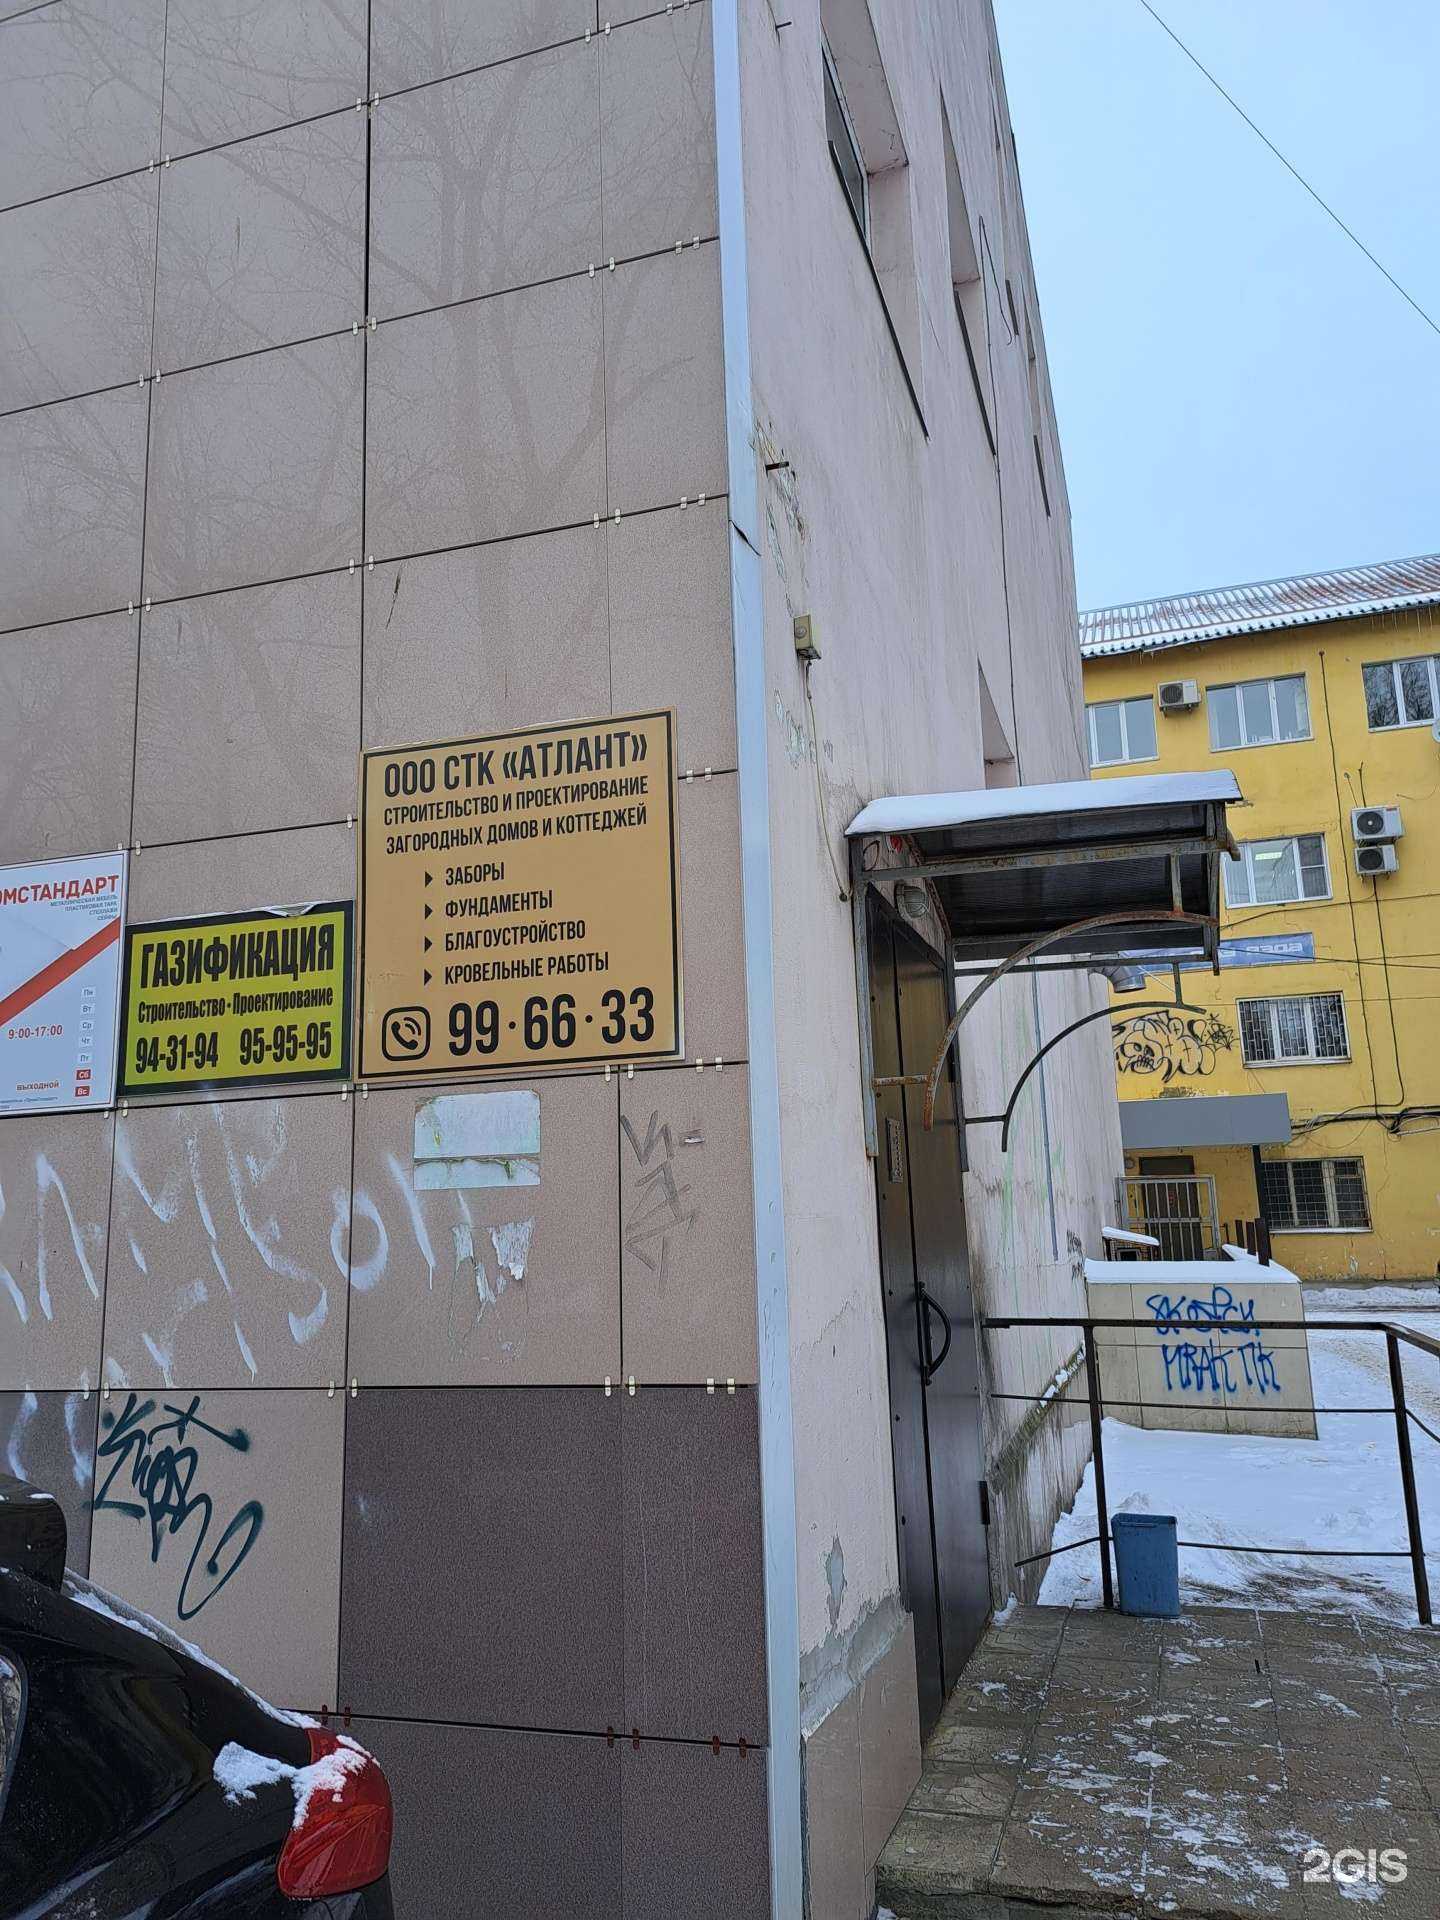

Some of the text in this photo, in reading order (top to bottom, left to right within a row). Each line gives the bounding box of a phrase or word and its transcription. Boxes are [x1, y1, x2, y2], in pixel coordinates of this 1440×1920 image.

[384, 731, 648, 798] ООО СТК «АТЛАНТ»
[384, 775, 649, 826] СТРОИТЕЛЬСТВО И ПРОЕКТИРОВАНИЕ
[386, 802, 647, 855] ЗАГОРОДНЫХ ДОМОВ И КОТТЕДЖЕЙ
[0, 875, 119, 906] МСТАНДАРТ
[445, 861, 505, 886] ЗАБОРЫ
[445, 890, 553, 919] ФУНДАМЕНТЫ
[445, 919, 586, 952] БЛАГОУСТРОЙСТВО
[140, 923, 335, 989] ГАЗИФИКАЦИЯ
[445, 951, 609, 985] КРОВЕЛЬНЫЕ РАБОТЫ
[138, 987, 333, 1024] Строительство Проектирование
[8, 1024, 63, 1039] 9:00-17:00
[135, 1021, 332, 1073] 94-31-94 95-95-95
